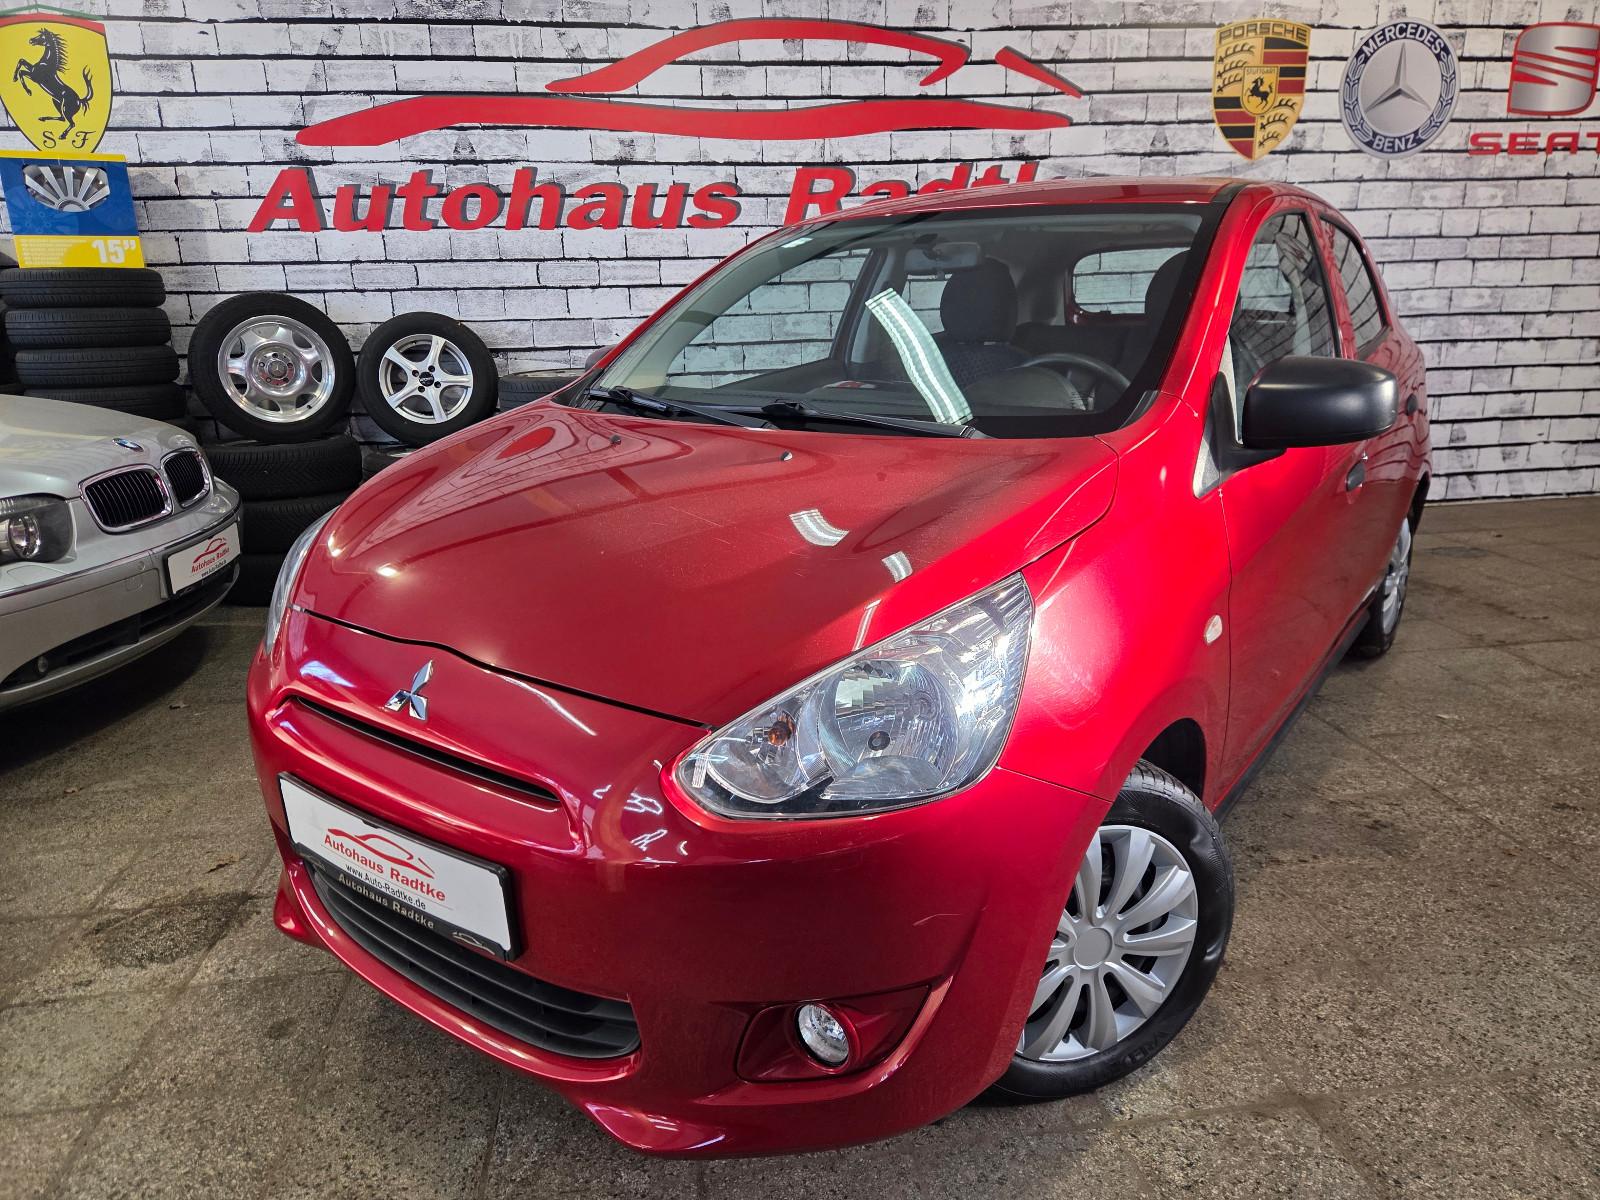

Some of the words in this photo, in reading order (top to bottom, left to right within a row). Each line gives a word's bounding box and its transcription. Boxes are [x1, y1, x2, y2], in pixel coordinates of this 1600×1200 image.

[1219, 23, 1307, 45] PORSCHE
[1361, 23, 1445, 57] MERCEDES
[1372, 133, 1417, 152] BENZ
[247, 166, 742, 232] Autohaus
[324, 834, 384, 874] Autohaus
[390, 866, 446, 902] Radtke
[345, 863, 426, 911] www.Auto-Radtke.de
[338, 873, 388, 906] Autohaus
[392, 901, 434, 929] Radtke
